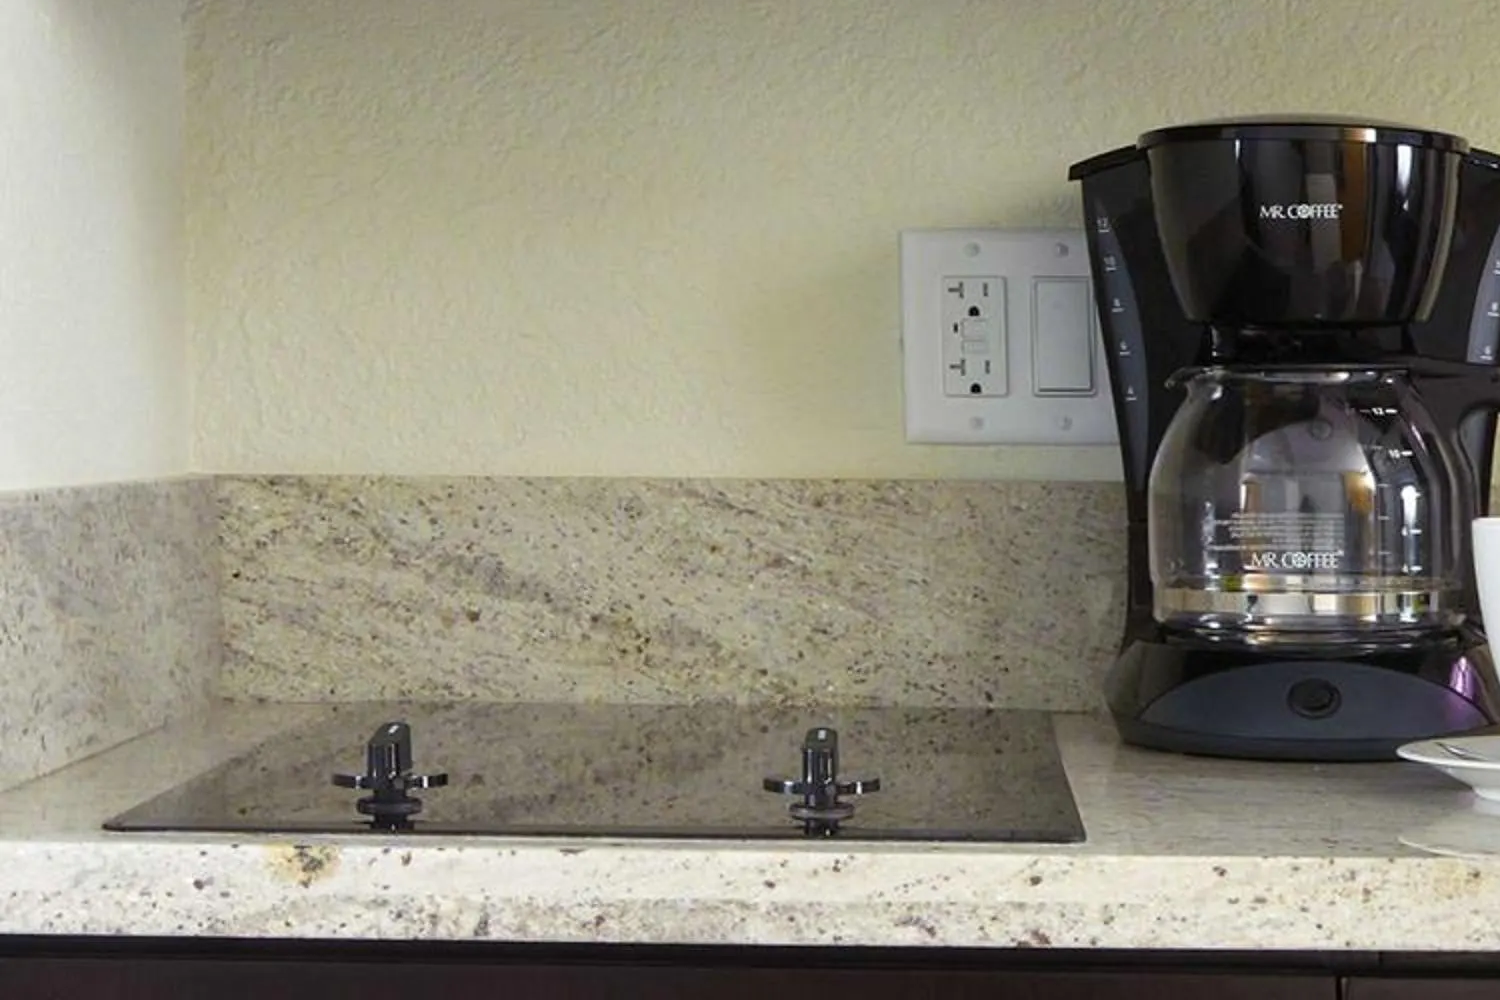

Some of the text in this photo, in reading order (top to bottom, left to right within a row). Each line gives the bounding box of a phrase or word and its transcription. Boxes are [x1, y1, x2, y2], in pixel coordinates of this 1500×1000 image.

[1259, 203, 1340, 220] MR. COFFEE
[1250, 551, 1339, 569] MR. COFFEE
